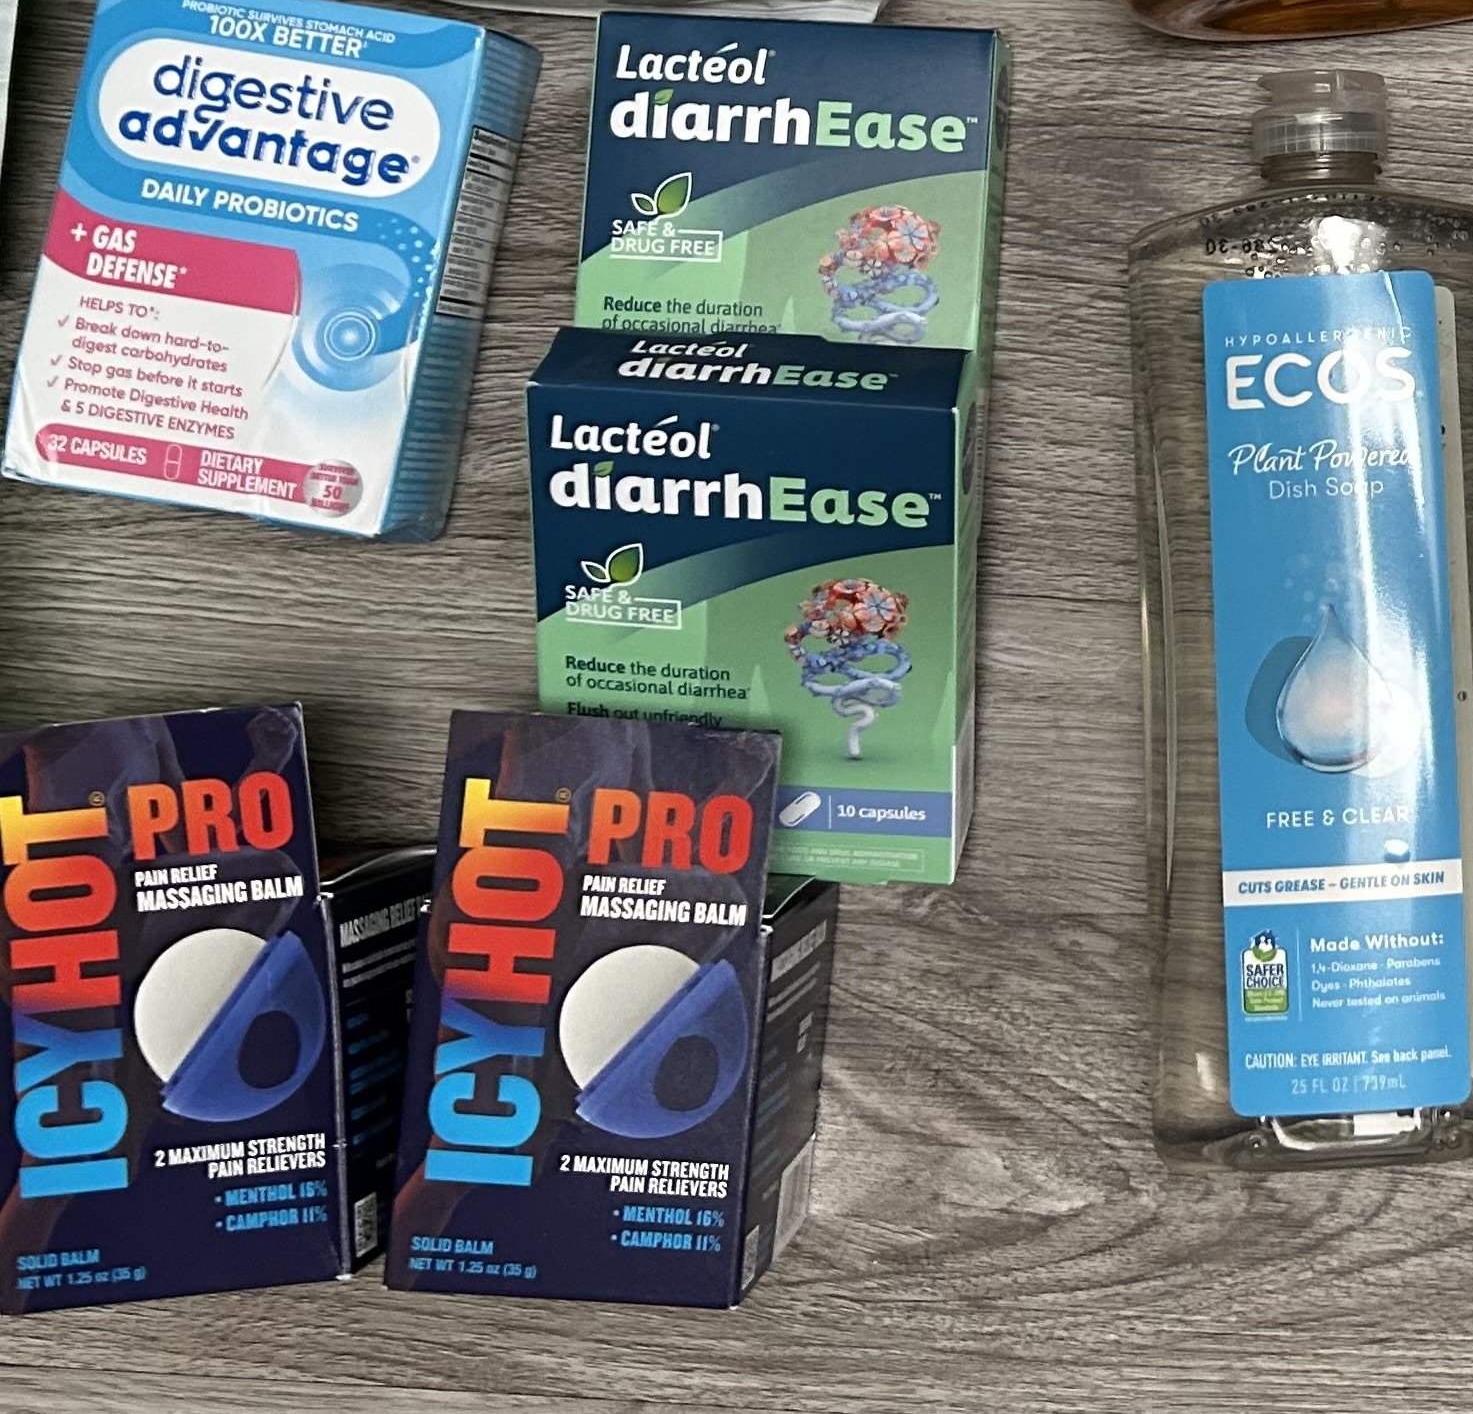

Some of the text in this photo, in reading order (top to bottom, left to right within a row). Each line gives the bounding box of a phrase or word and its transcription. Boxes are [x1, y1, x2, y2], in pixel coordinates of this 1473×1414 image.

[209, 15, 267, 43] 100X
[248, 9, 303, 28] SURVIVES
[305, 19, 364, 39] STOMACH
[365, 29, 396, 44] ACID
[615, 42, 770, 85] Lactéol
[153, 54, 395, 132] digestive
[118, 109, 411, 187] advantage
[140, 178, 360, 233] DAILY PROBIOTICS
[92, 224, 138, 254] GAS
[79, 295, 125, 315] HELPS
[75, 316, 230, 354] Break down hard-to-
[71, 337, 229, 373] digest carbohydrates
[68, 356, 243, 398] Stop gas before it starts
[1225, 346, 1416, 410] ECOS
[64, 377, 250, 421] Promote Digestive Health
[60, 399, 235, 440] & 5 DIGESTIVE ENZYMES
[550, 414, 713, 460] Lactéol
[70, 435, 148, 466] CAPSULES
[200, 449, 263, 474] DIETARY
[1228, 442, 1307, 476] Plant
[197, 469, 298, 501] SUPPLEMENT
[1269, 476, 1384, 500] Dish Sop
[564, 584, 632, 604] SAFE &
[565, 601, 674, 623] DRUG FREE
[565, 655, 730, 681] Reduce the duration
[566, 672, 583, 687] of
[586, 676, 673, 695] occasional
[127, 771, 294, 860] PRO
[837, 804, 927, 822] 10 capsules
[1266, 805, 1410, 829] FREE & CLEAR
[587, 788, 754, 875] PRO
[582, 875, 667, 896] PAIN RELIEF
[1238, 871, 1445, 895] CUTS GREASE GENTLE ON SKIN
[580, 895, 747, 927] MASSAGING BALM
[1310, 932, 1444, 953] Made Without:
[1246, 963, 1285, 977] SAFER
[1387, 956, 1441, 971] Parabens
[1246, 975, 1285, 989] CHOICE
[1311, 974, 1411, 993] Dyes Phthalates
[1312, 990, 1446, 1009] Never tested on animals
[1301, 1053, 1319, 1067] EYE
[1371, 1050, 1390, 1064] See
[1393, 1048, 1419, 1062] back
[559, 1155, 730, 1181] 2 MAXIMUM STRENGTH
[609, 1175, 728, 1199] PAIN RELIEVERS
[623, 1205, 725, 1227] MENTHOL 16%
[411, 1236, 495, 1255] SOLID BALM
[620, 1230, 721, 1252] CAMPHOR 11%
